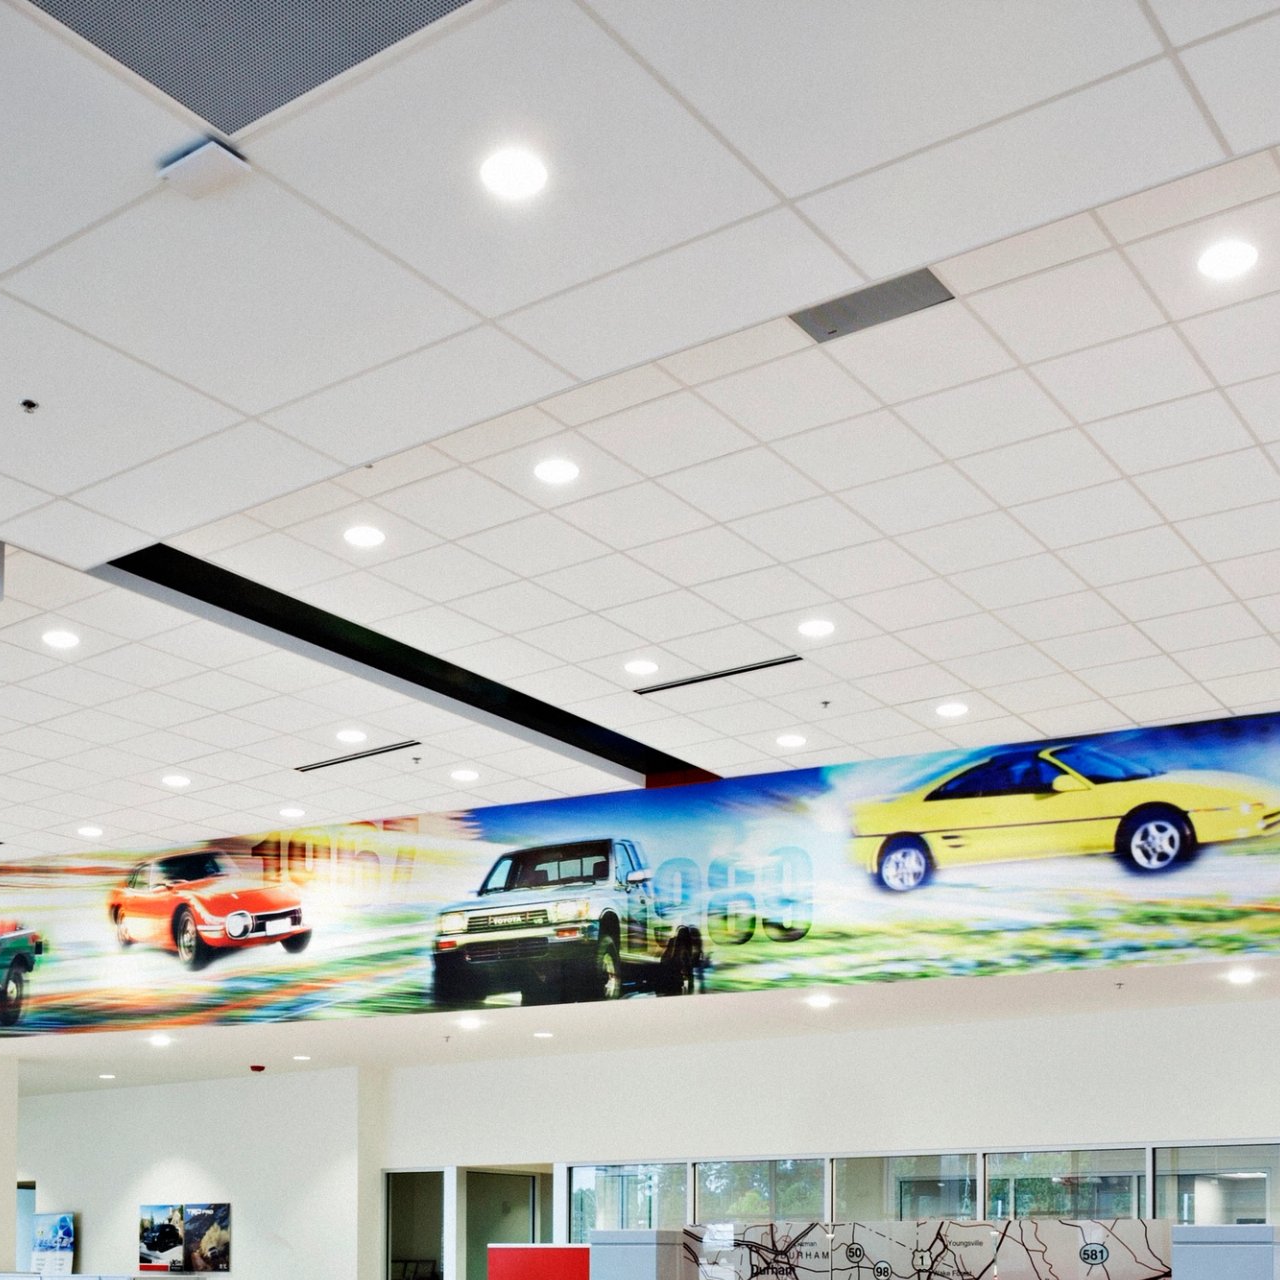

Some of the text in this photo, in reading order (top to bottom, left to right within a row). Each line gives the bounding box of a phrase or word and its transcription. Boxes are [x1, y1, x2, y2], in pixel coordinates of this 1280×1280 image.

[948, 1240, 984, 1248] Youngsville
[848, 1248, 862, 1258] 50
[1083, 1251, 1105, 1261] 581
[919, 1256, 925, 1266] 1
[751, 1264, 797, 1277] Durham
[875, 1266, 889, 1277] 98
